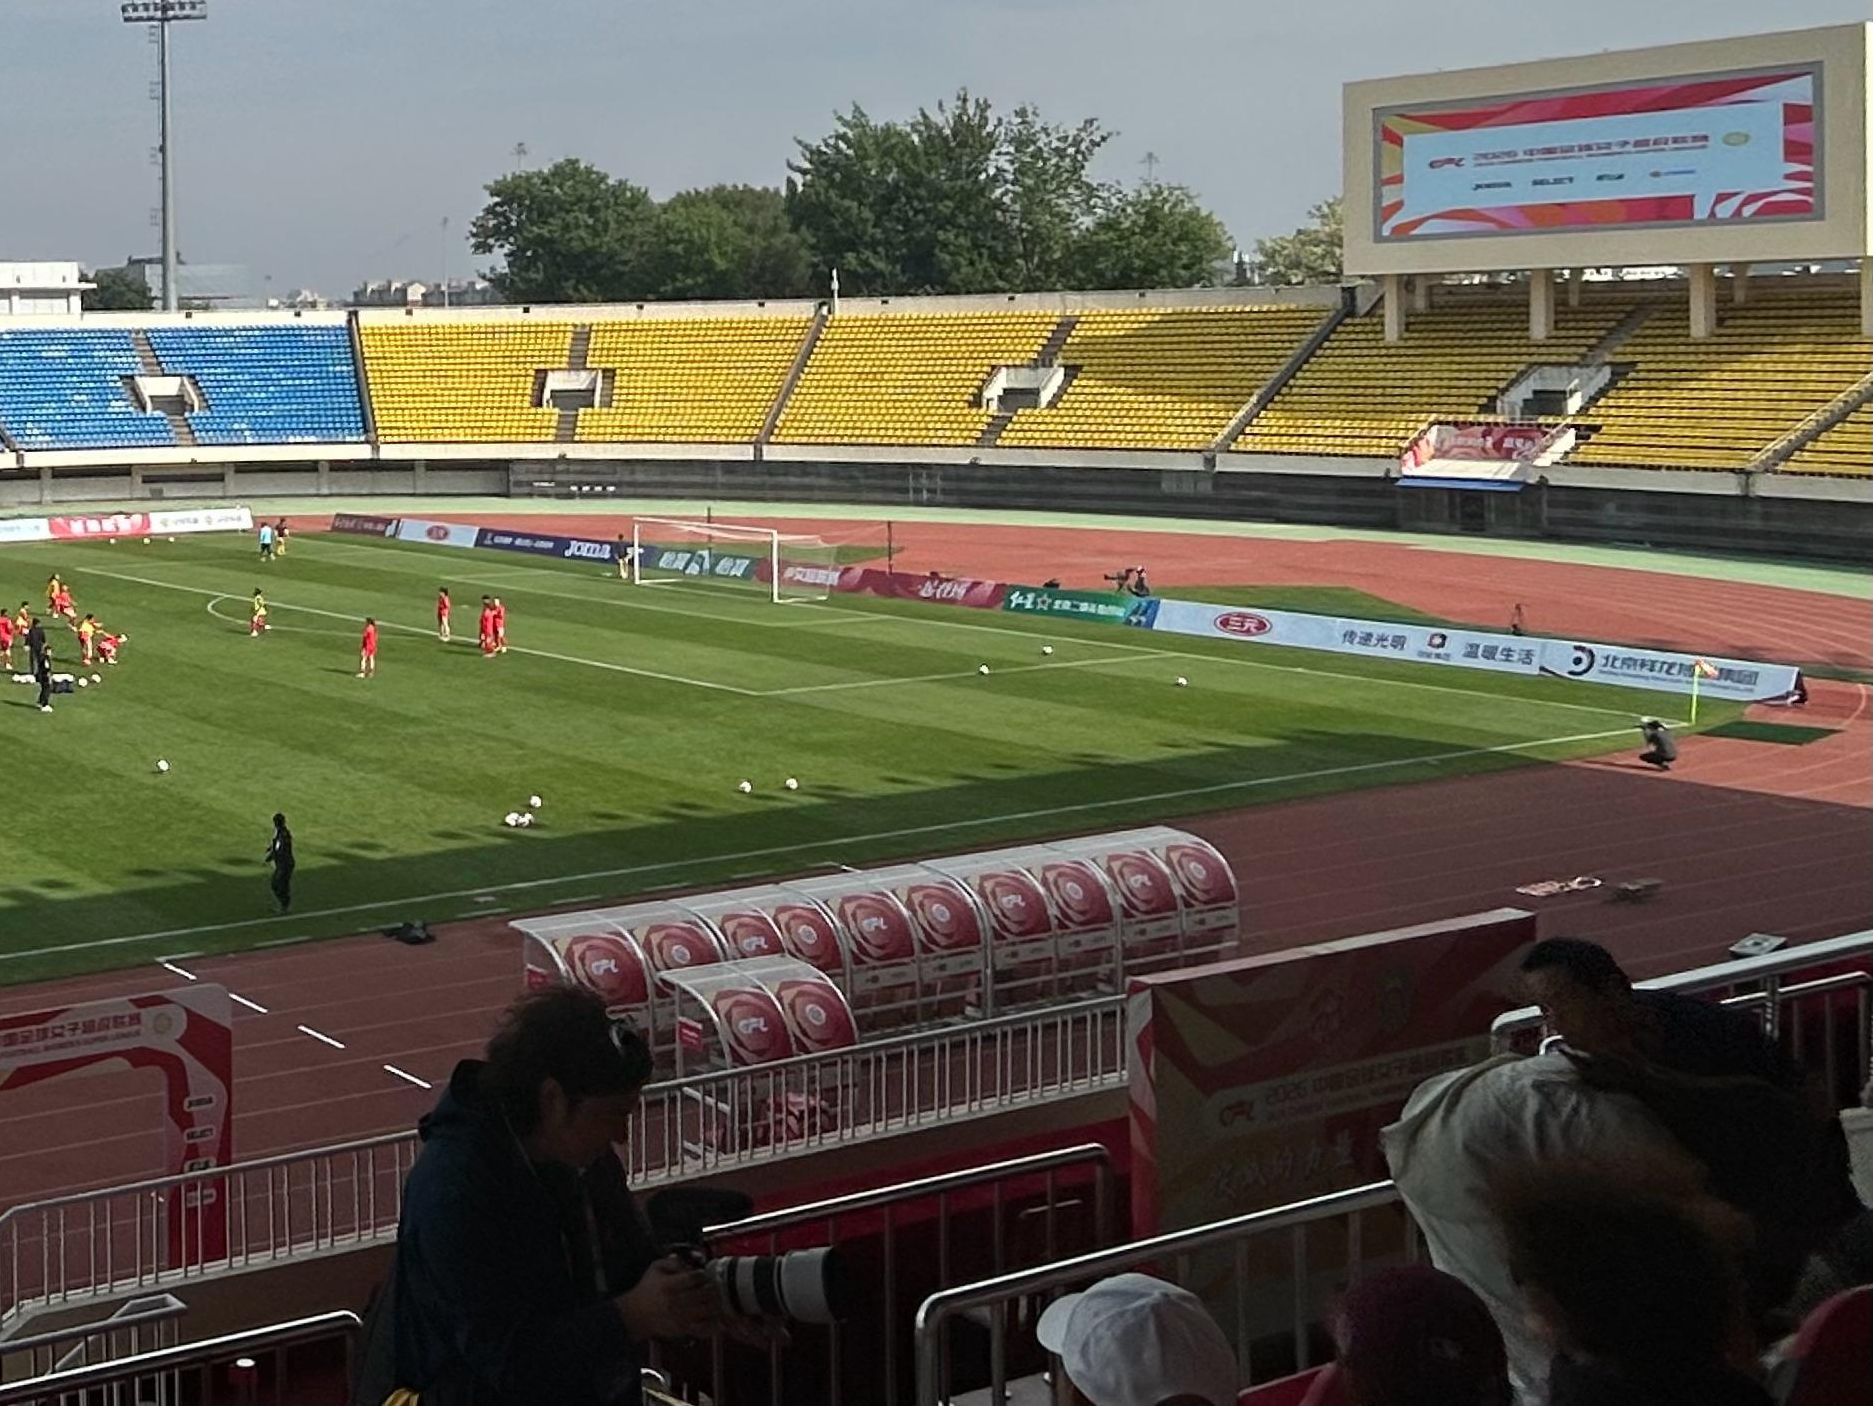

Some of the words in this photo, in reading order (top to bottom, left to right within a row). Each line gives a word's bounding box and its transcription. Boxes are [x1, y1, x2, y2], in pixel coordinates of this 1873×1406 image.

[1341, 629, 1408, 651] 传递光明
[1462, 642, 1535, 666] 温暖生活
